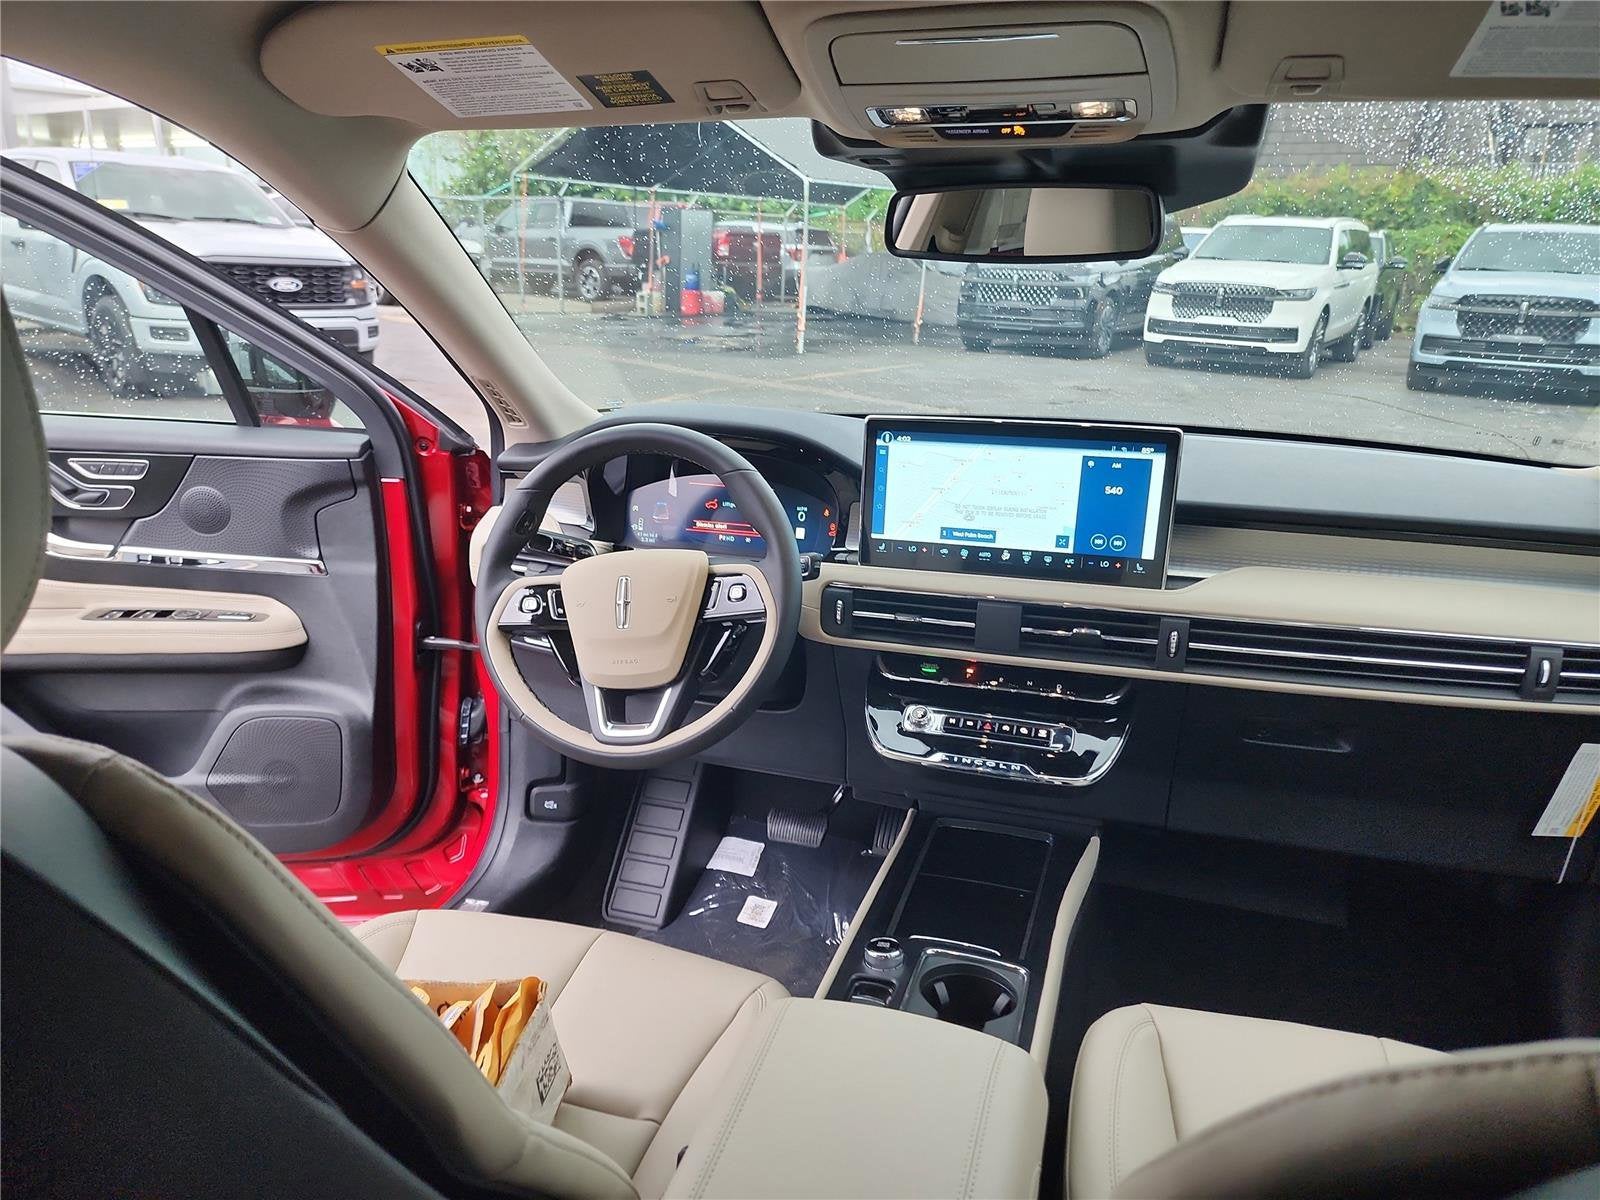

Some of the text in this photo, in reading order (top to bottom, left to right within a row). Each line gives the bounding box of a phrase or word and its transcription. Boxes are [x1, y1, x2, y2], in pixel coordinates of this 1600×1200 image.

[1104, 485, 1124, 496] 540
[964, 531, 977, 539] Palm
[977, 532, 994, 540] Beach
[908, 545, 917, 553] LO
[1100, 560, 1110, 568] LO
[941, 753, 1021, 772] LINCOLN
